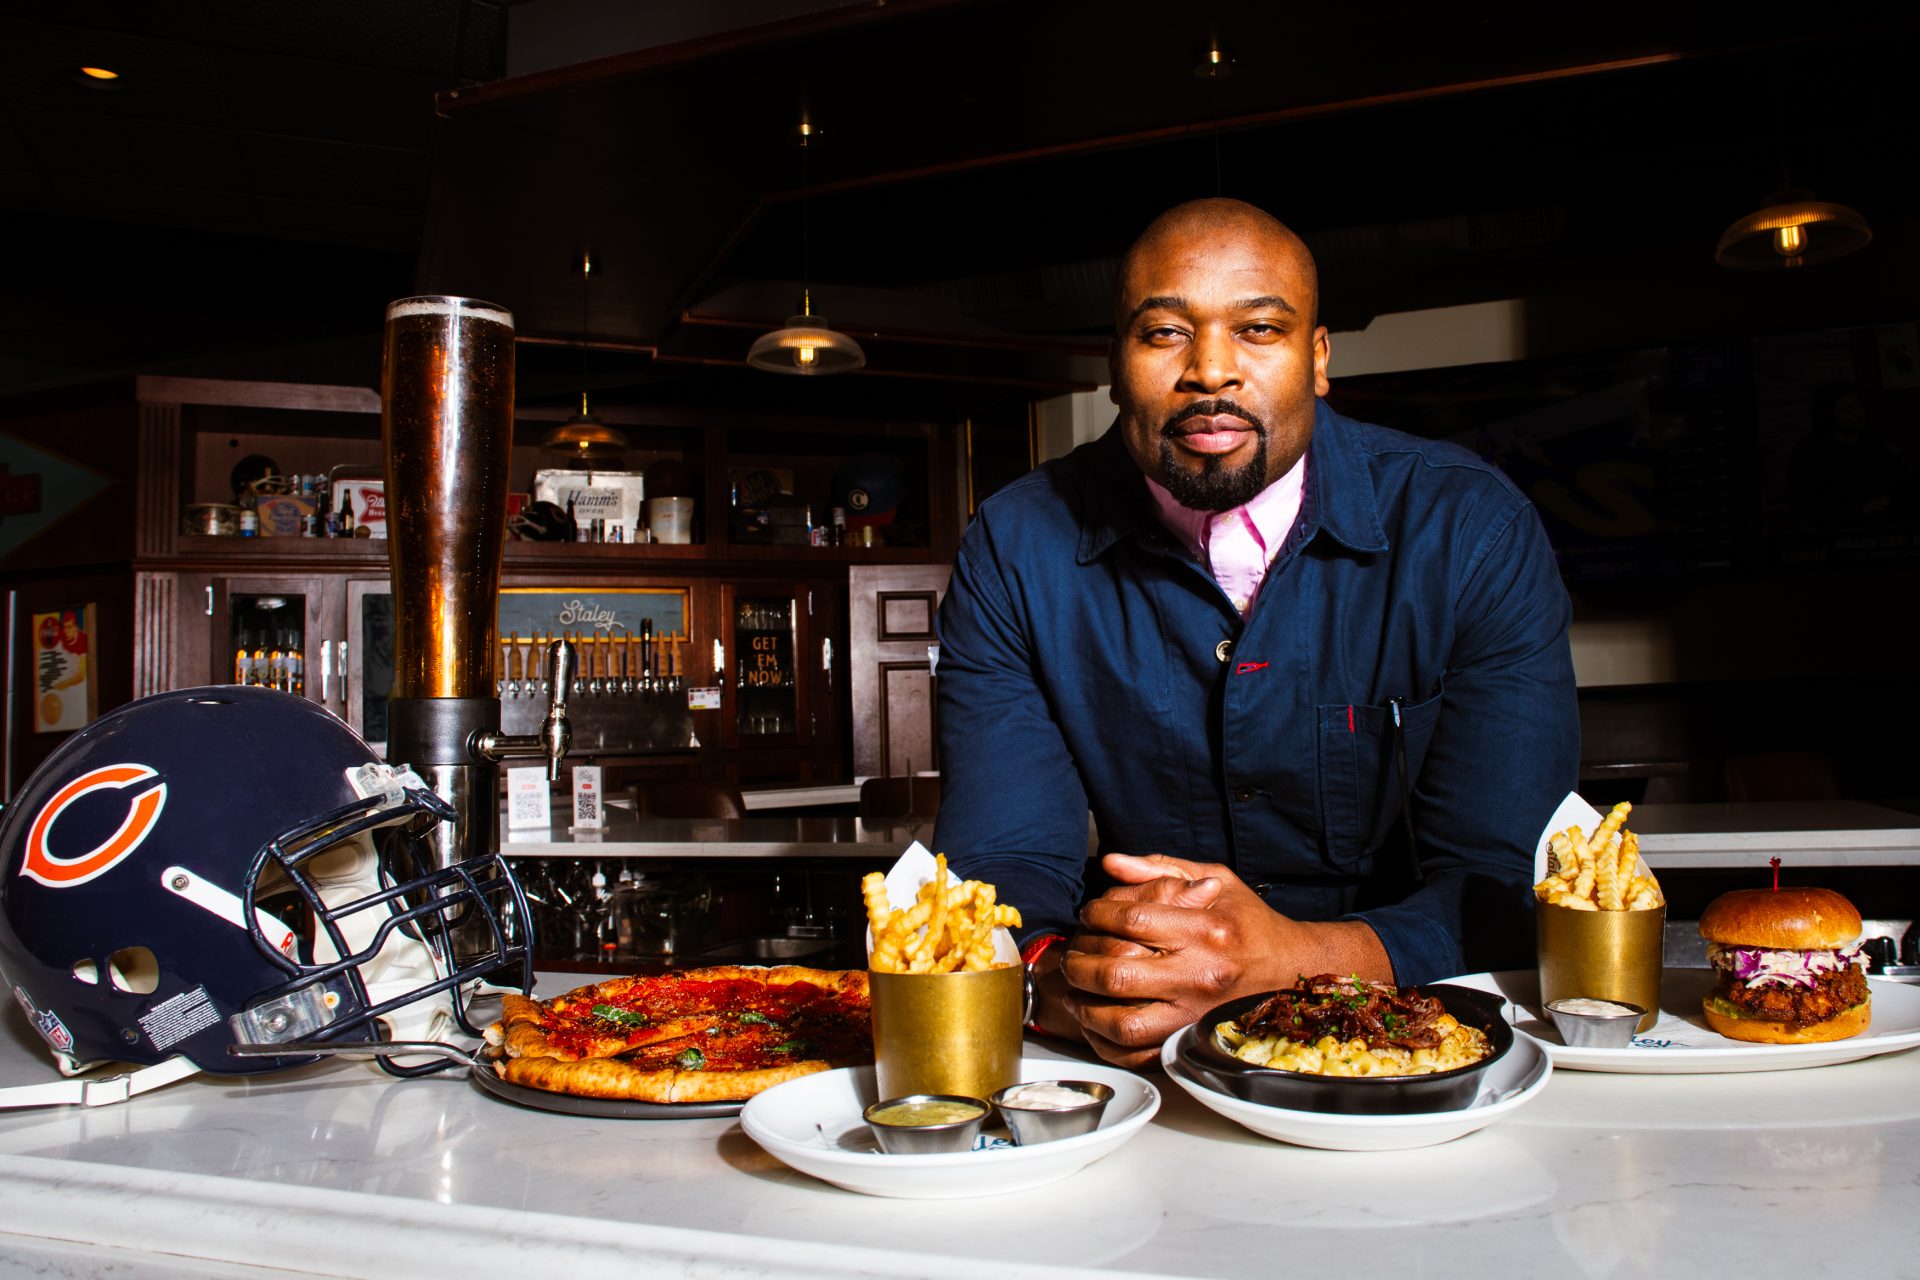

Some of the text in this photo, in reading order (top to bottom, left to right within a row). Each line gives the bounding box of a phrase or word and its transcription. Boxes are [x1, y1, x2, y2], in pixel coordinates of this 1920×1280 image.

[567, 490, 619, 506] Hamm's
[560, 599, 625, 632] Staley
[752, 636, 778, 651] GET
[748, 670, 783, 685] NOW
[150, 992, 186, 1013] WARNING
